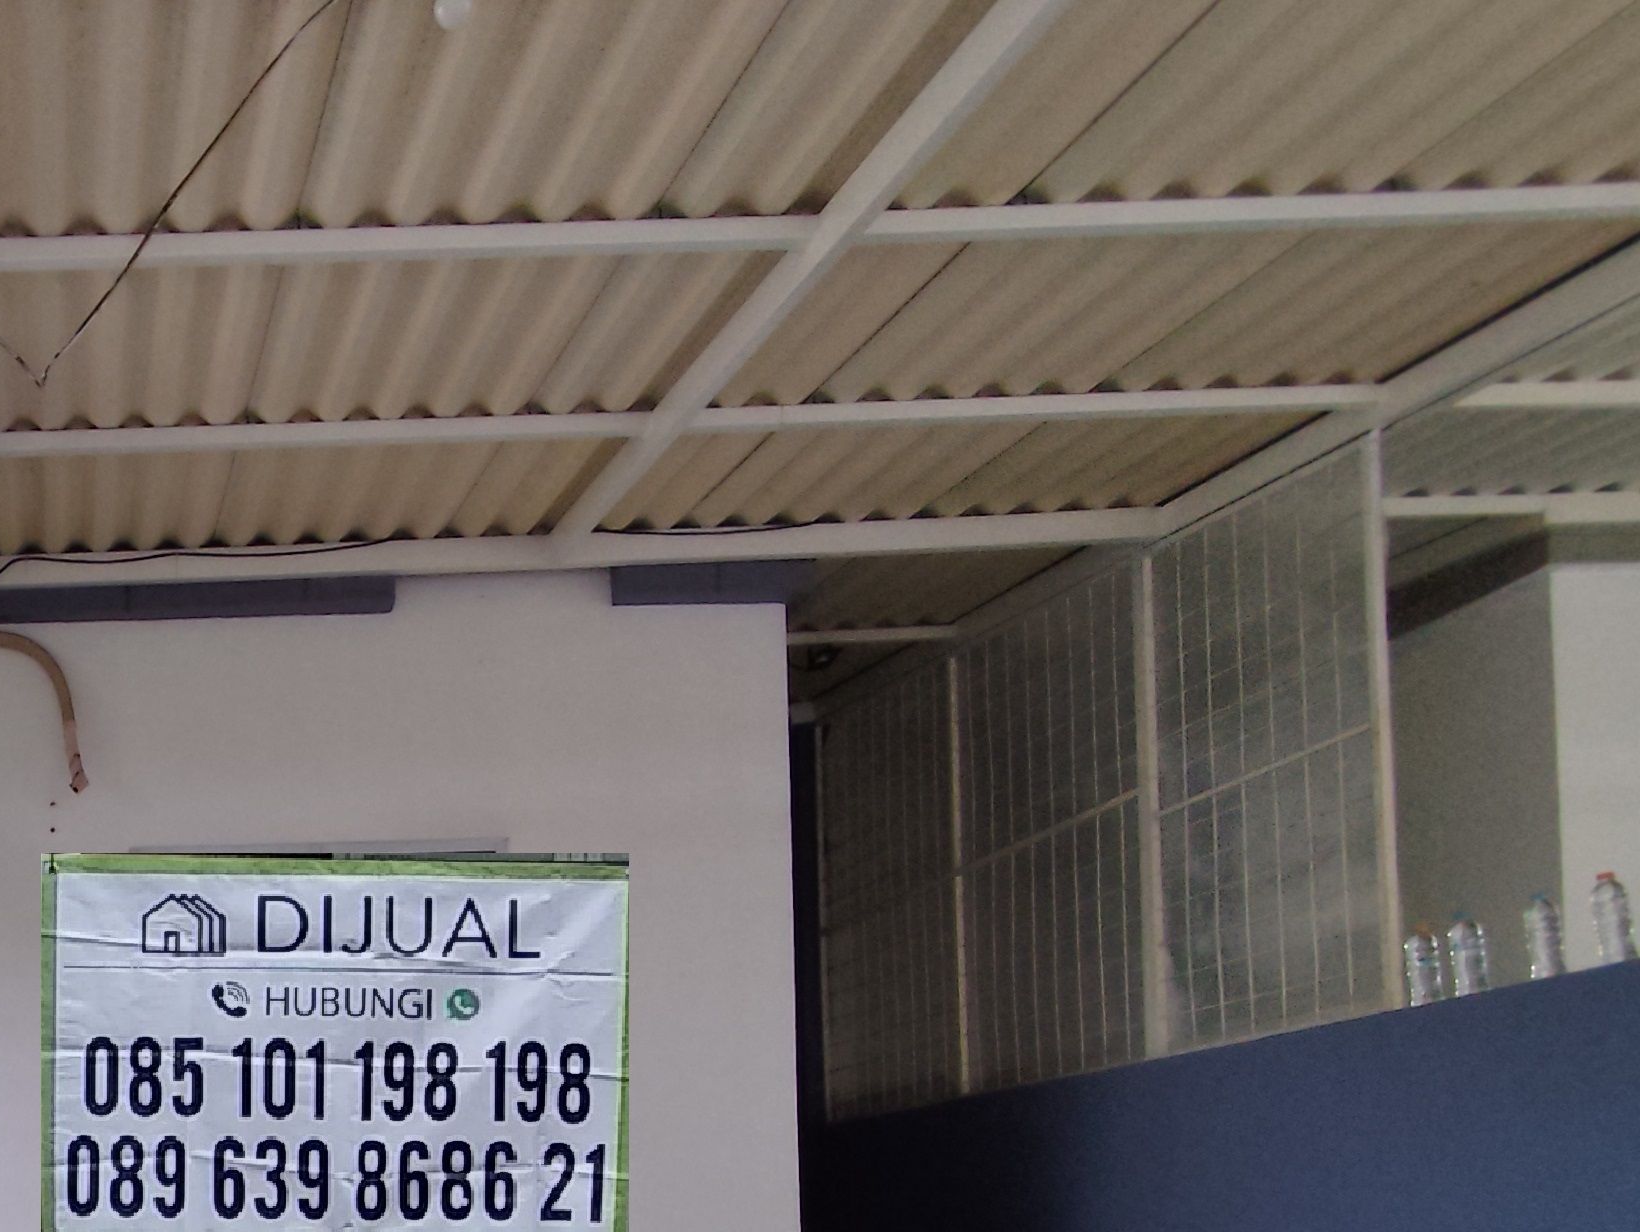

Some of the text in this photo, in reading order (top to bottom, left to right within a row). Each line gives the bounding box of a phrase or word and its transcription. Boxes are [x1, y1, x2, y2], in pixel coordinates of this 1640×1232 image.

[257, 895, 541, 959] DIJUAL
[265, 986, 433, 1021] HUBUNGI
[85, 1036, 591, 1125] 085 101 198 198
[66, 1134, 186, 1219] 089
[213, 1135, 329, 1221] 639
